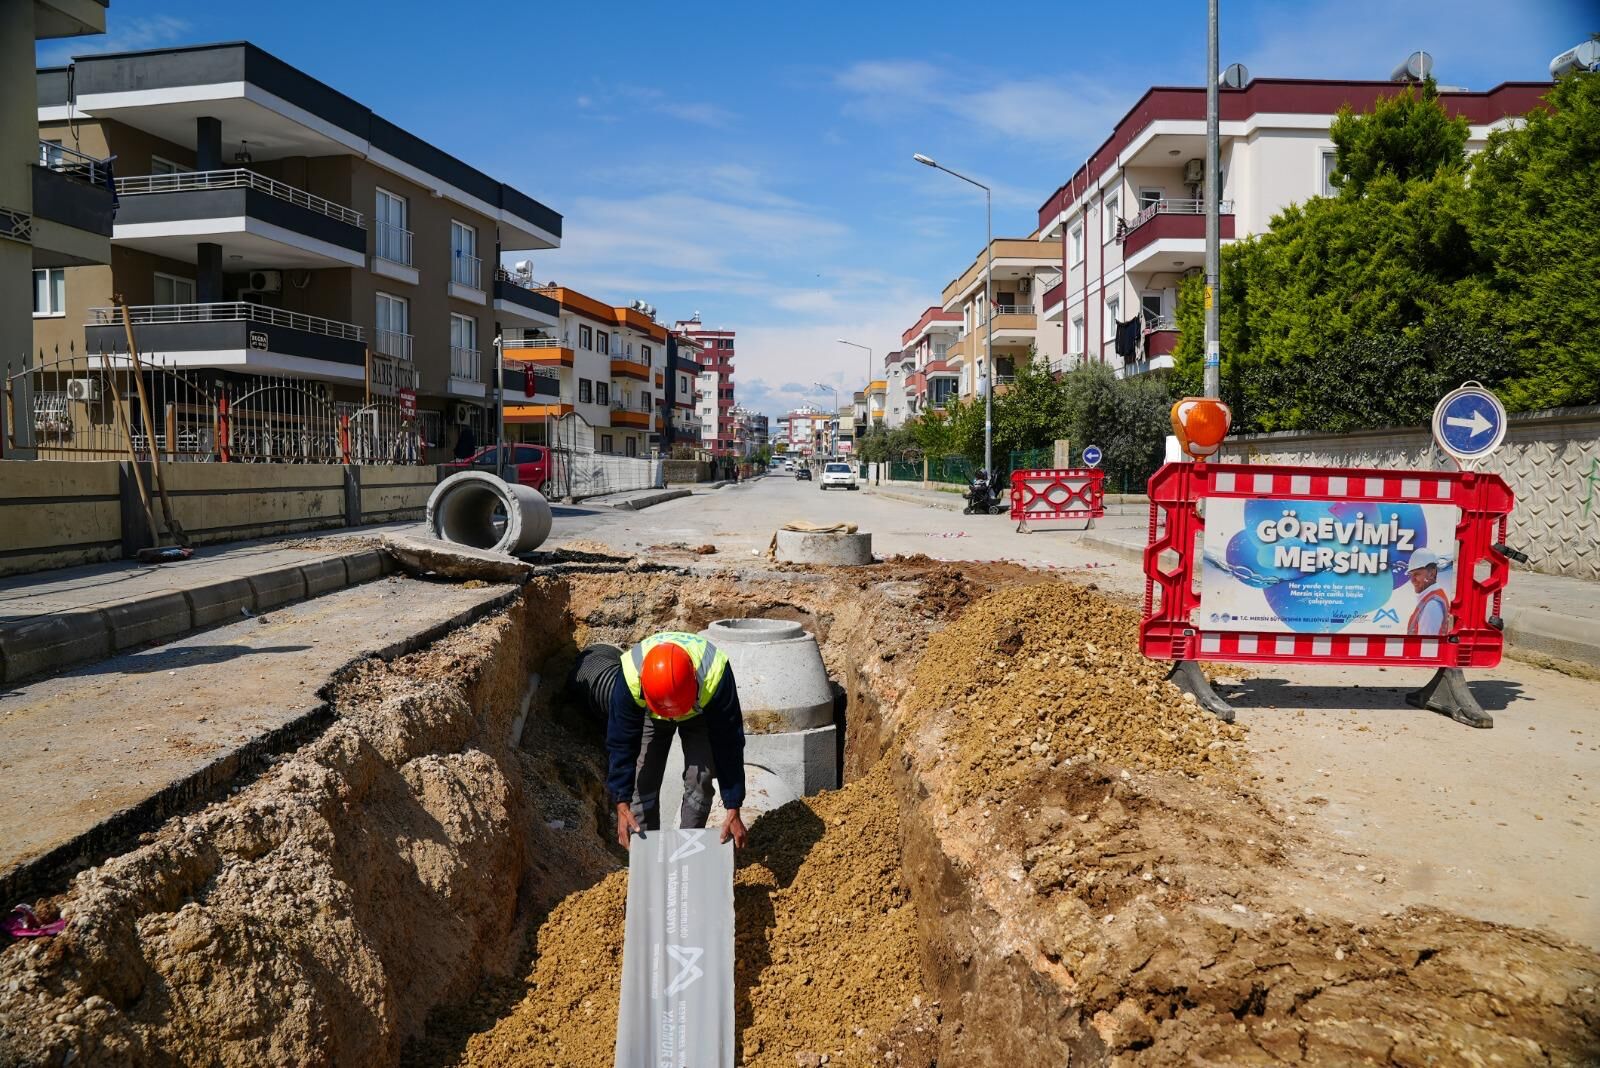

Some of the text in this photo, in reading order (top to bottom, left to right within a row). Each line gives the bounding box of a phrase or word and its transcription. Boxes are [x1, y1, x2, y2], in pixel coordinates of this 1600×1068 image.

[372, 362, 392, 392] BARIŞ
[1256, 510, 1414, 550] GÖREVİMİZ
[1274, 546, 1388, 574] MERSİN!
[666, 872, 678, 934] YAĞMUR SUYU
[661, 1010, 674, 1057] YAĞMUR
